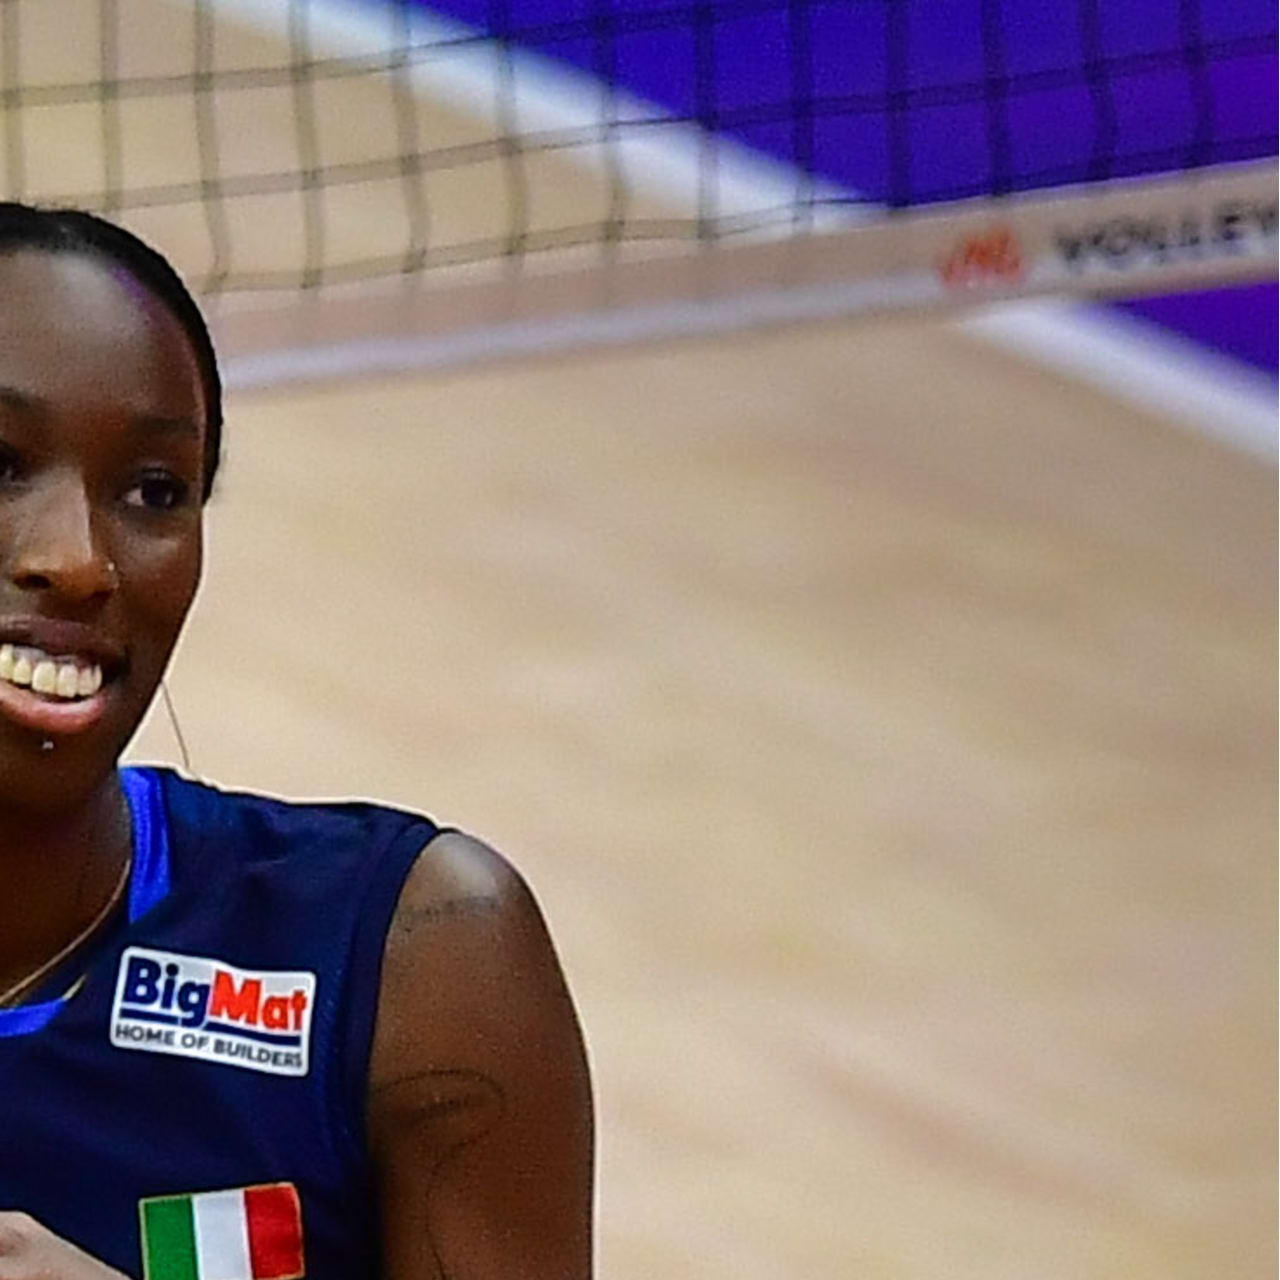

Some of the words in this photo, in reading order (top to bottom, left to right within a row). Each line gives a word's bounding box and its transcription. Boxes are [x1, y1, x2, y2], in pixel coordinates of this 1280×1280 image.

[122, 956, 307, 1029] BigMat
[114, 1023, 175, 1046] HOME
[181, 1031, 209, 1051] OF
[213, 1038, 303, 1068] BUILDERS
